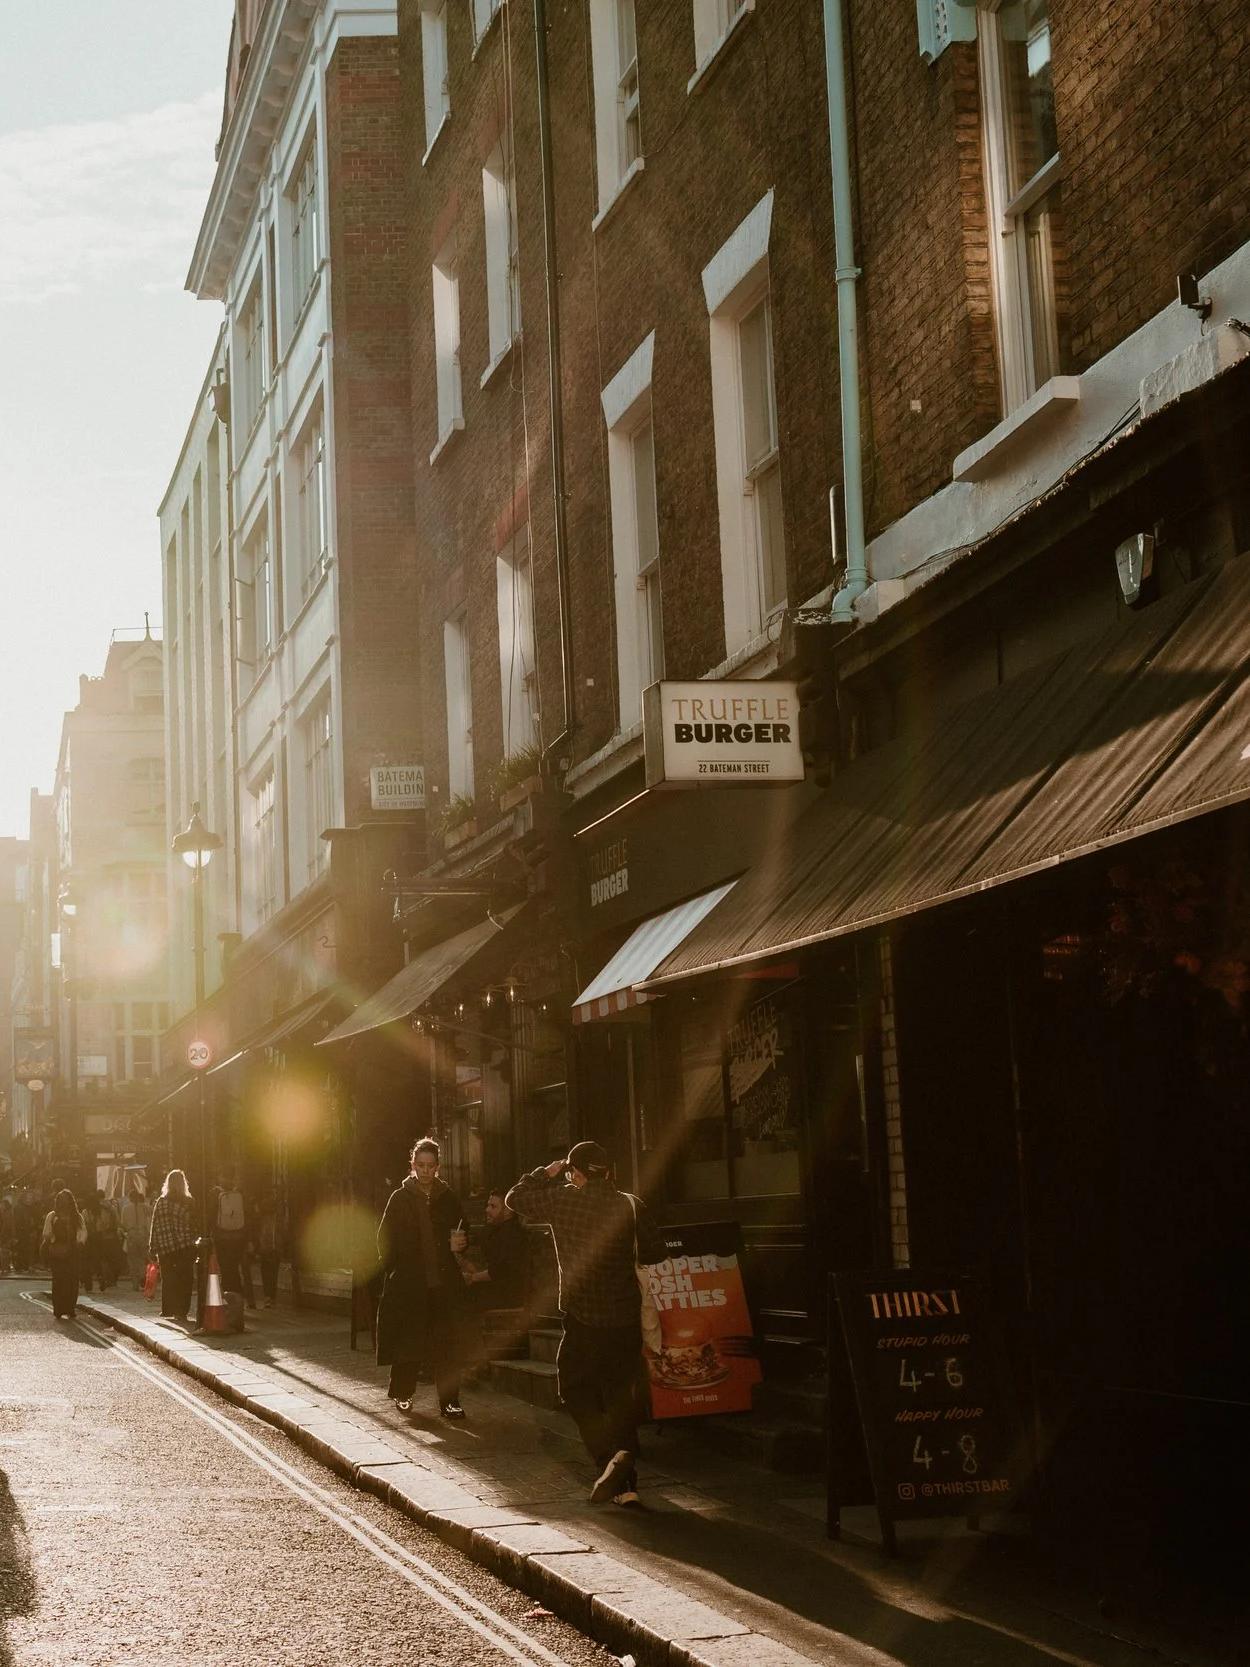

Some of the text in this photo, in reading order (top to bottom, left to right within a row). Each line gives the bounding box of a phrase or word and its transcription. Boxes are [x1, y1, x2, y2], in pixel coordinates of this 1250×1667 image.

[671, 698, 790, 721] TRUFFLE
[674, 722, 792, 744] BURGER
[377, 770, 424, 783] BATEMA
[698, 763, 770, 774] 22 BATEMAN STREET
[378, 783, 425, 796] BUILDIN
[589, 838, 628, 881] TRUFFLE
[590, 866, 629, 907] BURGER
[190, 1047, 208, 1060] 20
[650, 1274, 694, 1295] OSH
[866, 1290, 962, 1319] THIRST
[876, 1334, 971, 1350] STUPID HOUR
[895, 1406, 985, 1423] HAPPY HOUR
[920, 1478, 1011, 1497] @THIRSTBAR
